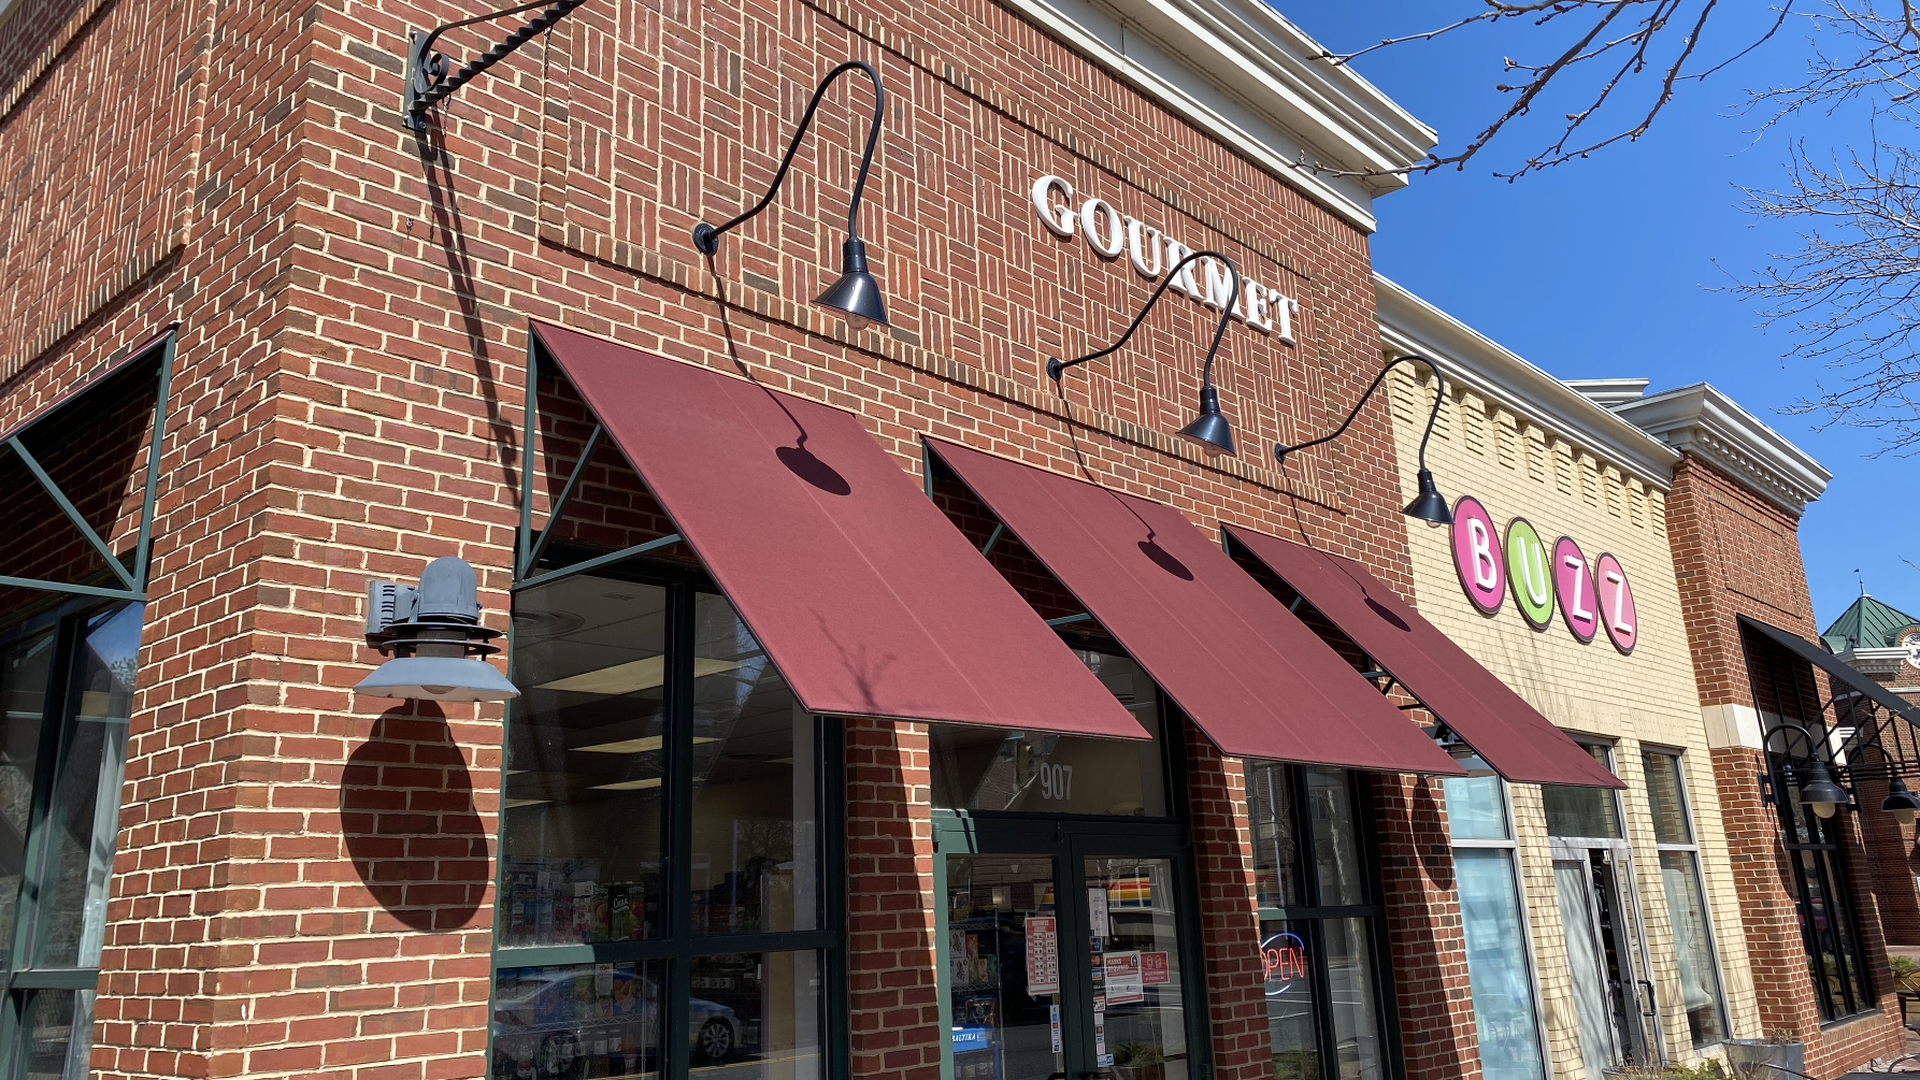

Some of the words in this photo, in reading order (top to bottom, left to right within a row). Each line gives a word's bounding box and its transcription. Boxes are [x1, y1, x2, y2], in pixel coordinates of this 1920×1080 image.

[1032, 175, 1298, 344] GOURMET
[1467, 517, 1633, 635] BUZZ
[1040, 762, 1072, 800] 907
